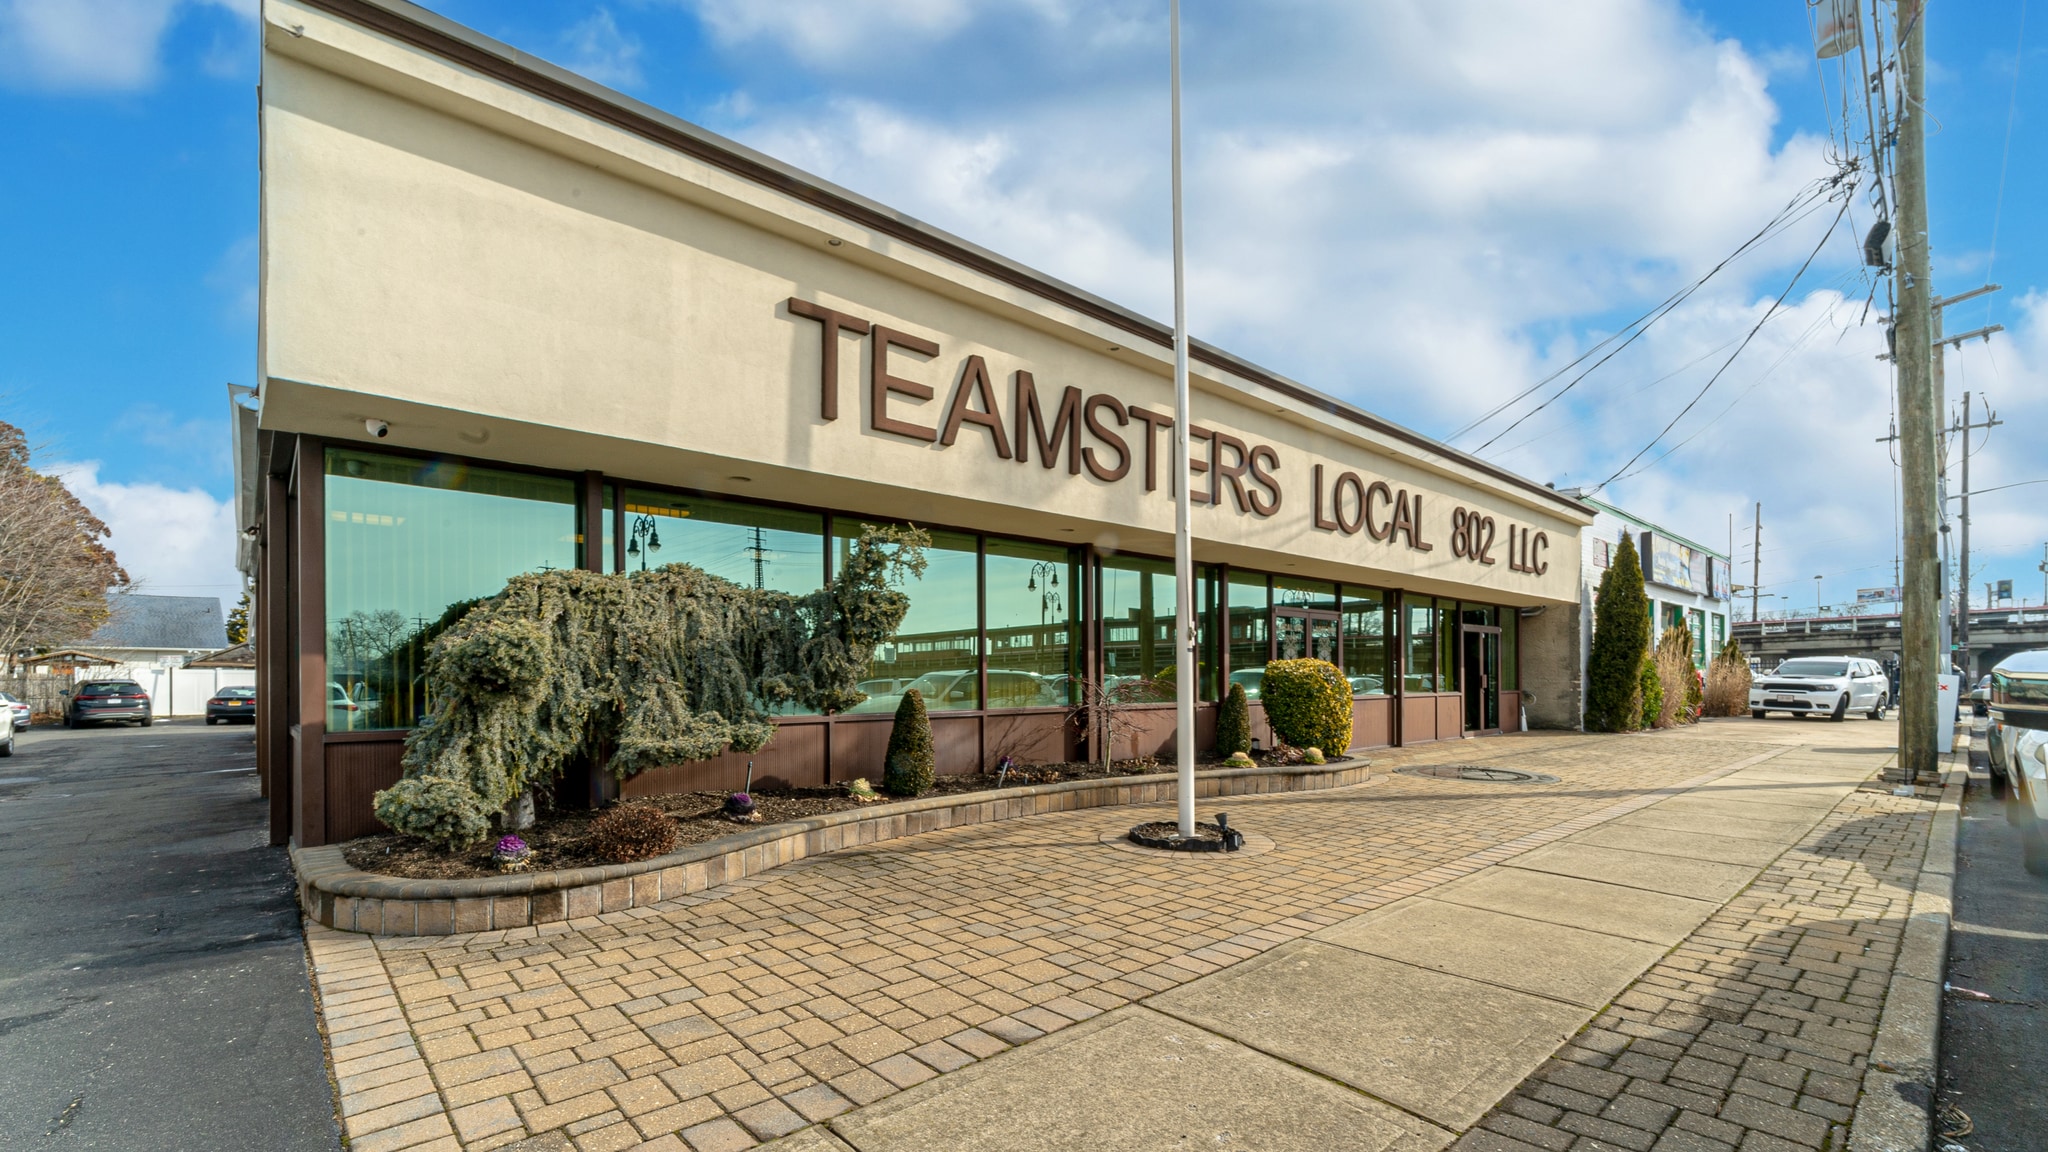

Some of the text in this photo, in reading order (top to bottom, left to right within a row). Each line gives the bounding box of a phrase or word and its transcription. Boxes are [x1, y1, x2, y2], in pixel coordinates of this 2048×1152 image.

[788, 297, 1283, 517] TEAMSTERS
[1315, 464, 1433, 551] LOCAL
[1452, 507, 1496, 565] 802
[1510, 524, 1550, 576] LLC
